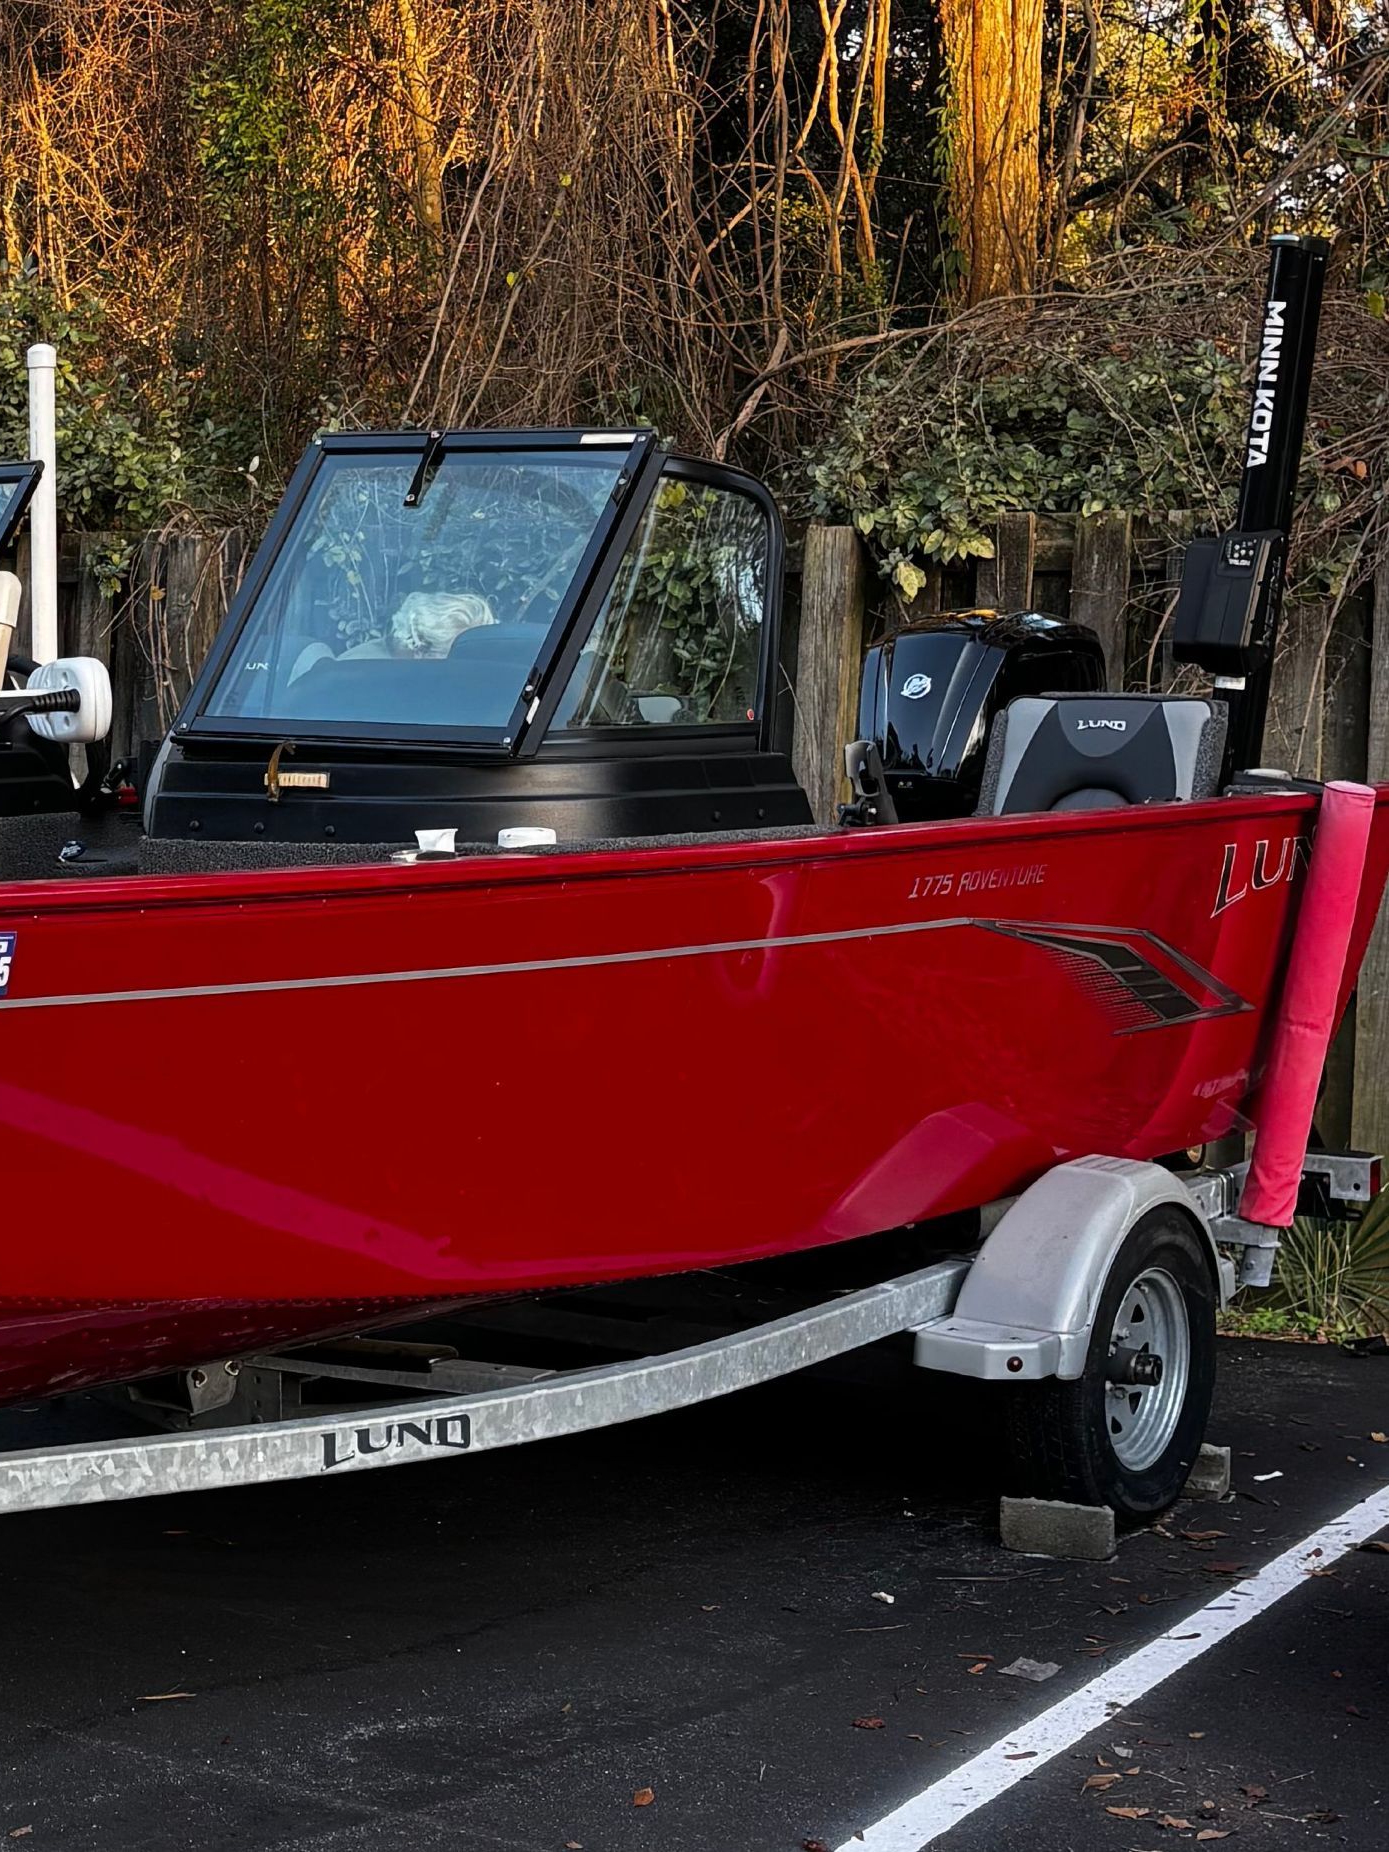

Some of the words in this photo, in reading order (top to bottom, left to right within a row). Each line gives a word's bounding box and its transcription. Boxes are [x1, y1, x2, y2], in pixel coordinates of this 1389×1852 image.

[1258, 301, 1287, 382] MINN
[1246, 389, 1275, 468] KOTA
[1077, 719, 1127, 732] LUND
[908, 873, 954, 899] 1775
[957, 864, 1048, 896] ADVENTURE
[1210, 836, 1314, 919] LUN
[320, 1414, 471, 1472] LUND
